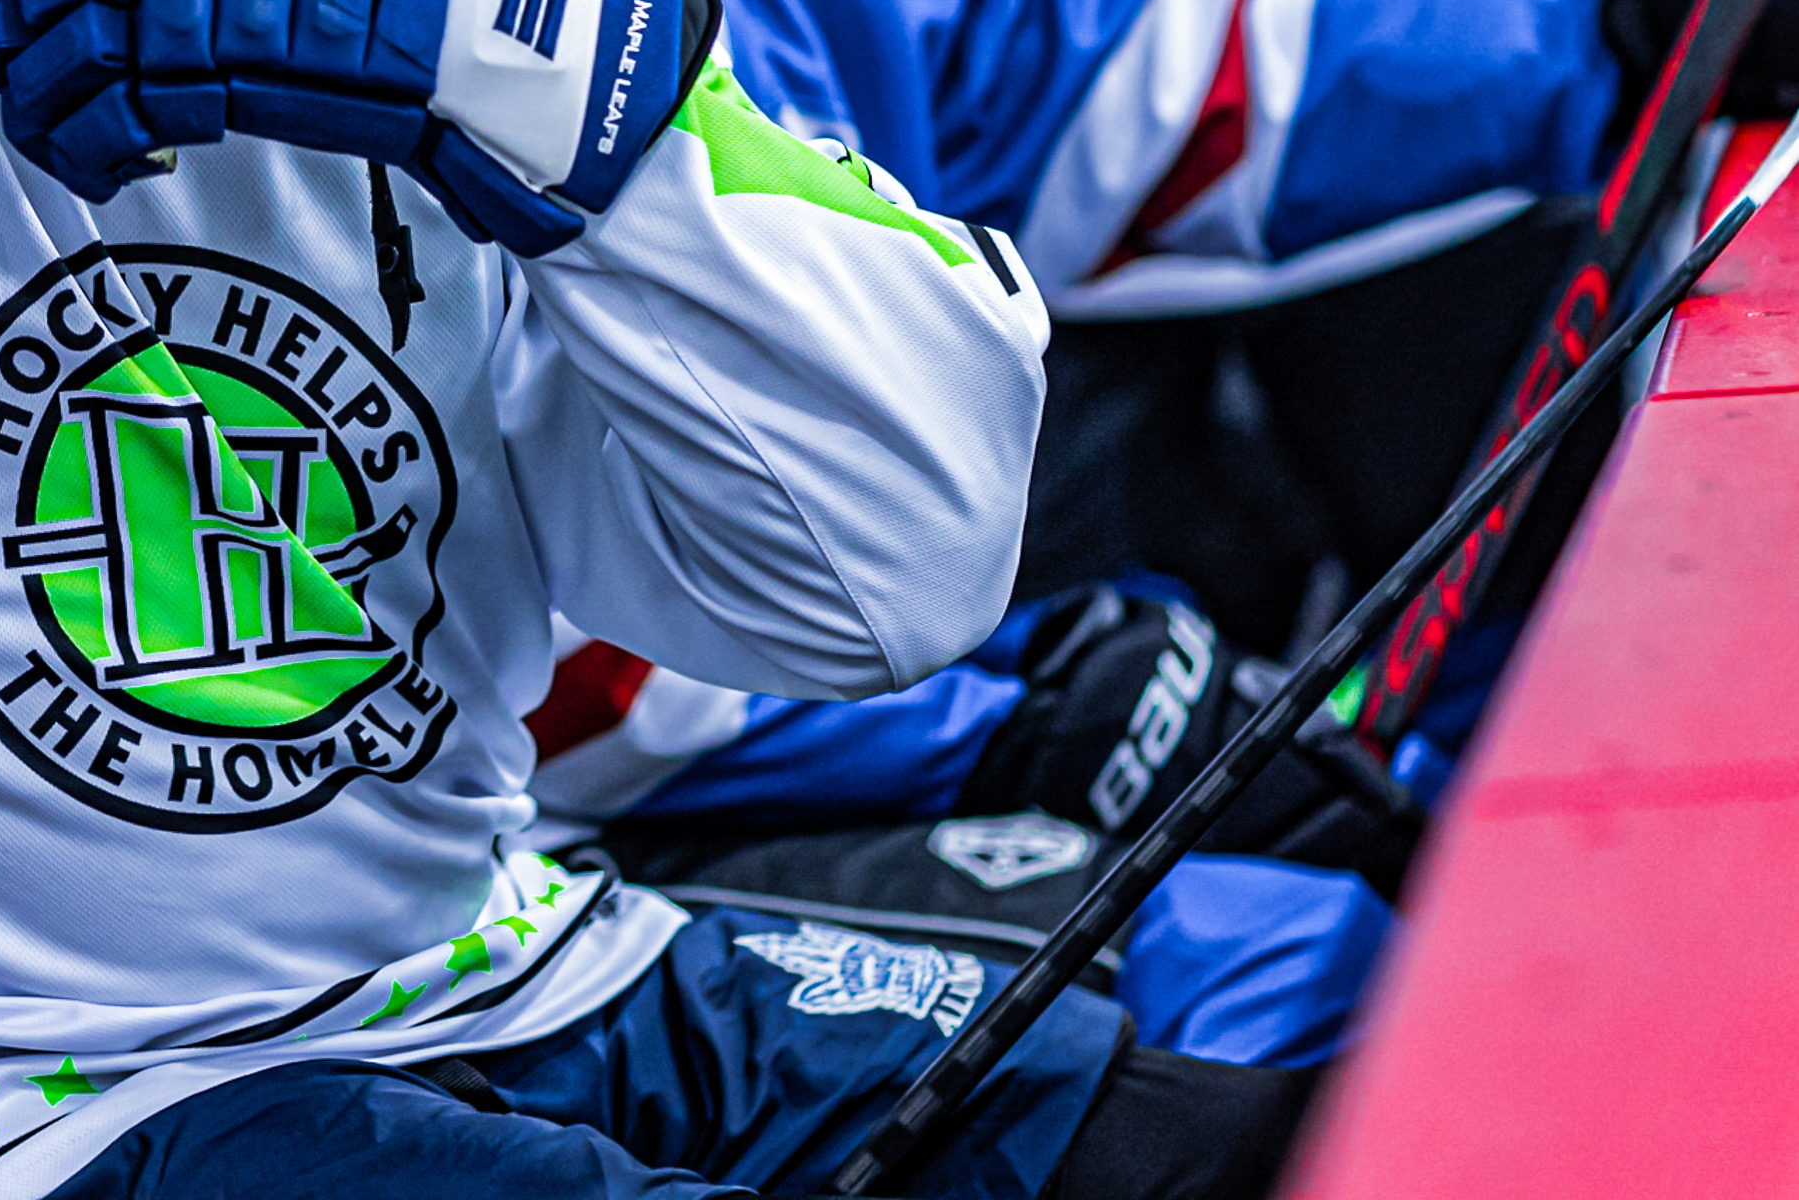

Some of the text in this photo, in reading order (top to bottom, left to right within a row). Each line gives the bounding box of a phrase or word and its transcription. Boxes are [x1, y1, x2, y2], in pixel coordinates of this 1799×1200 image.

[597, 0, 653, 156] MAPLE LEAFS
[213, 286, 419, 484] HELPS
[167, 653, 445, 805] HOMELE
